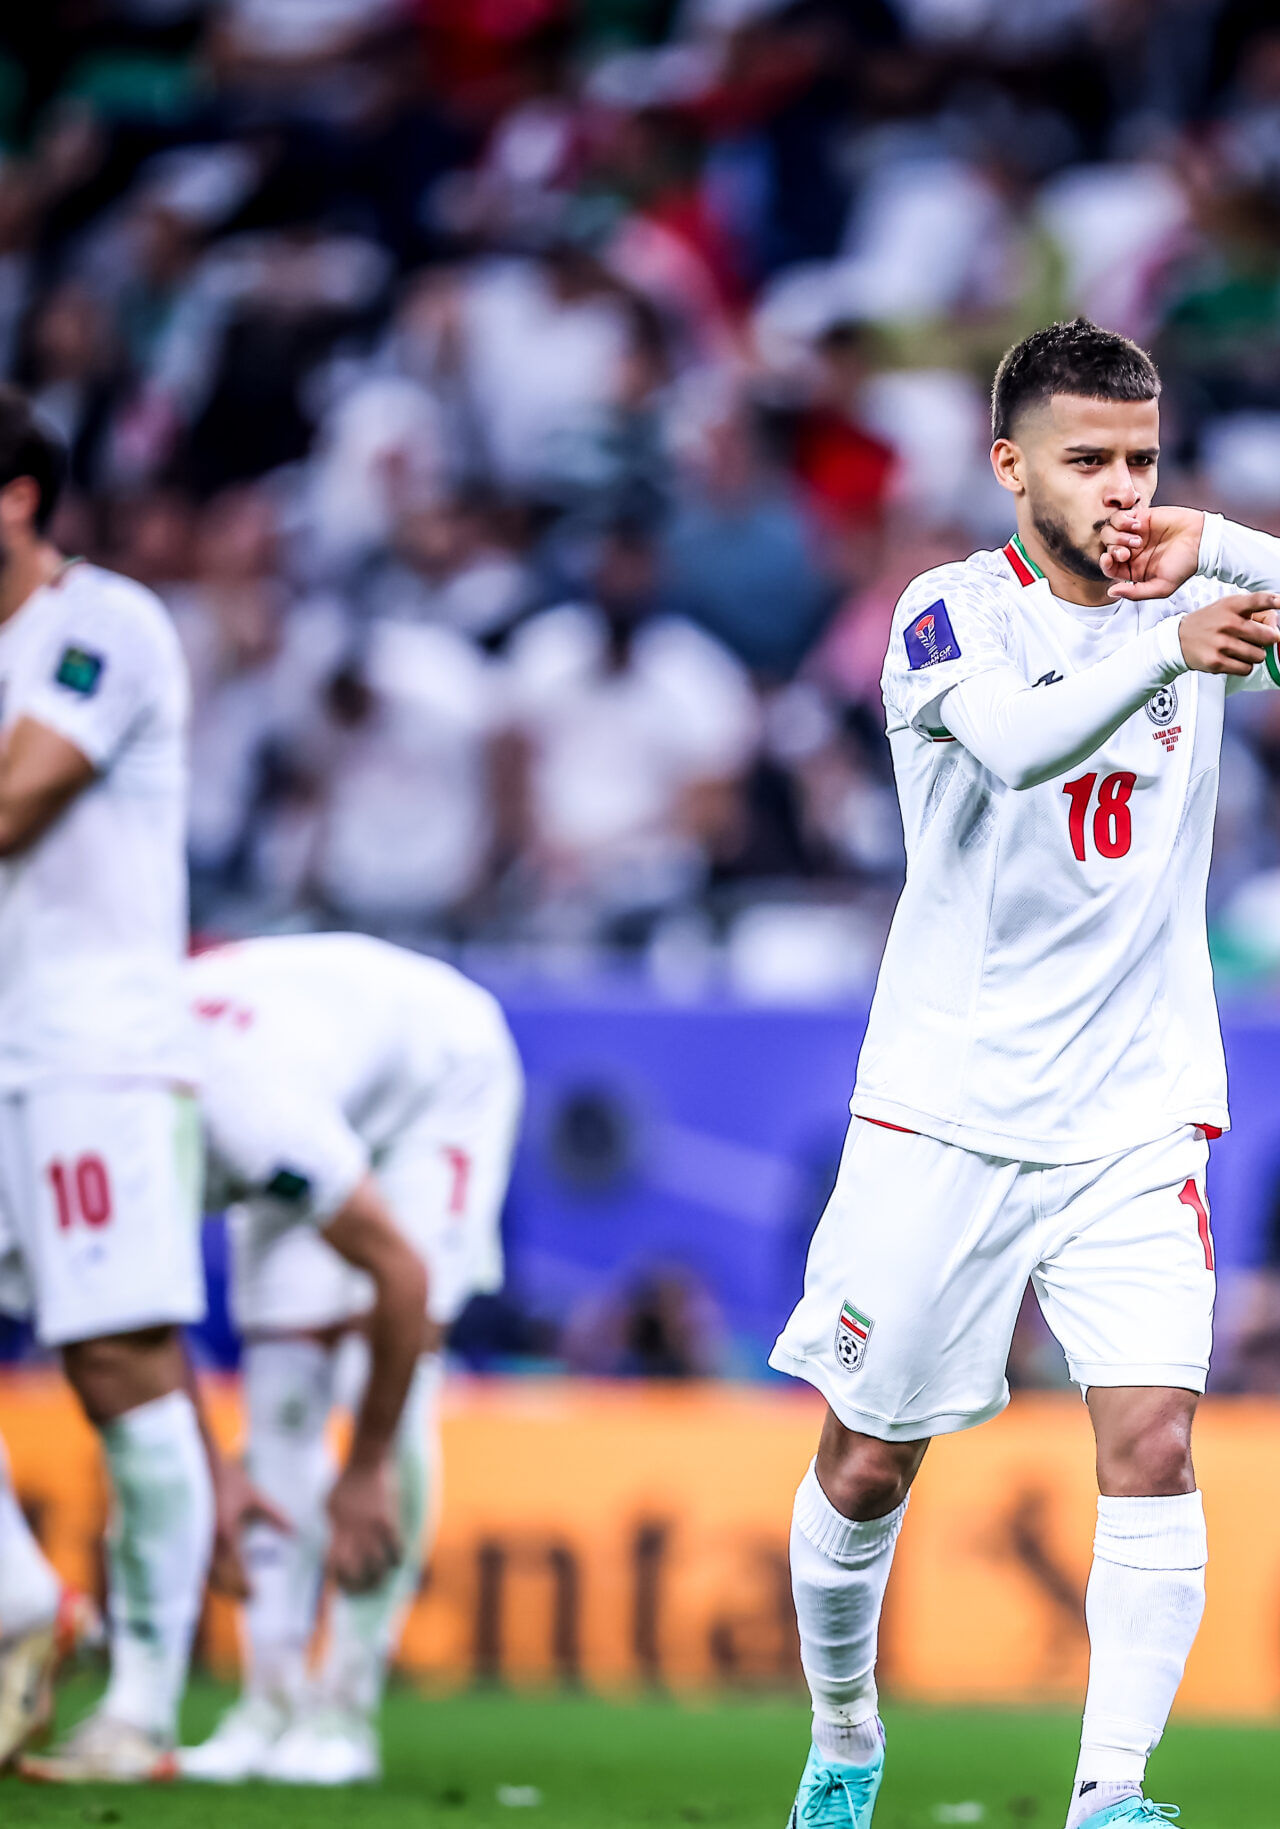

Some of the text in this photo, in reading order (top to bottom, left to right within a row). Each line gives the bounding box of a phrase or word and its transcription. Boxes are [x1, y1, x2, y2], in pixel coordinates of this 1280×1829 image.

[1062, 771, 1137, 861] 18
[45, 1153, 112, 1237] 10
[1178, 1179, 1213, 1271] 1
